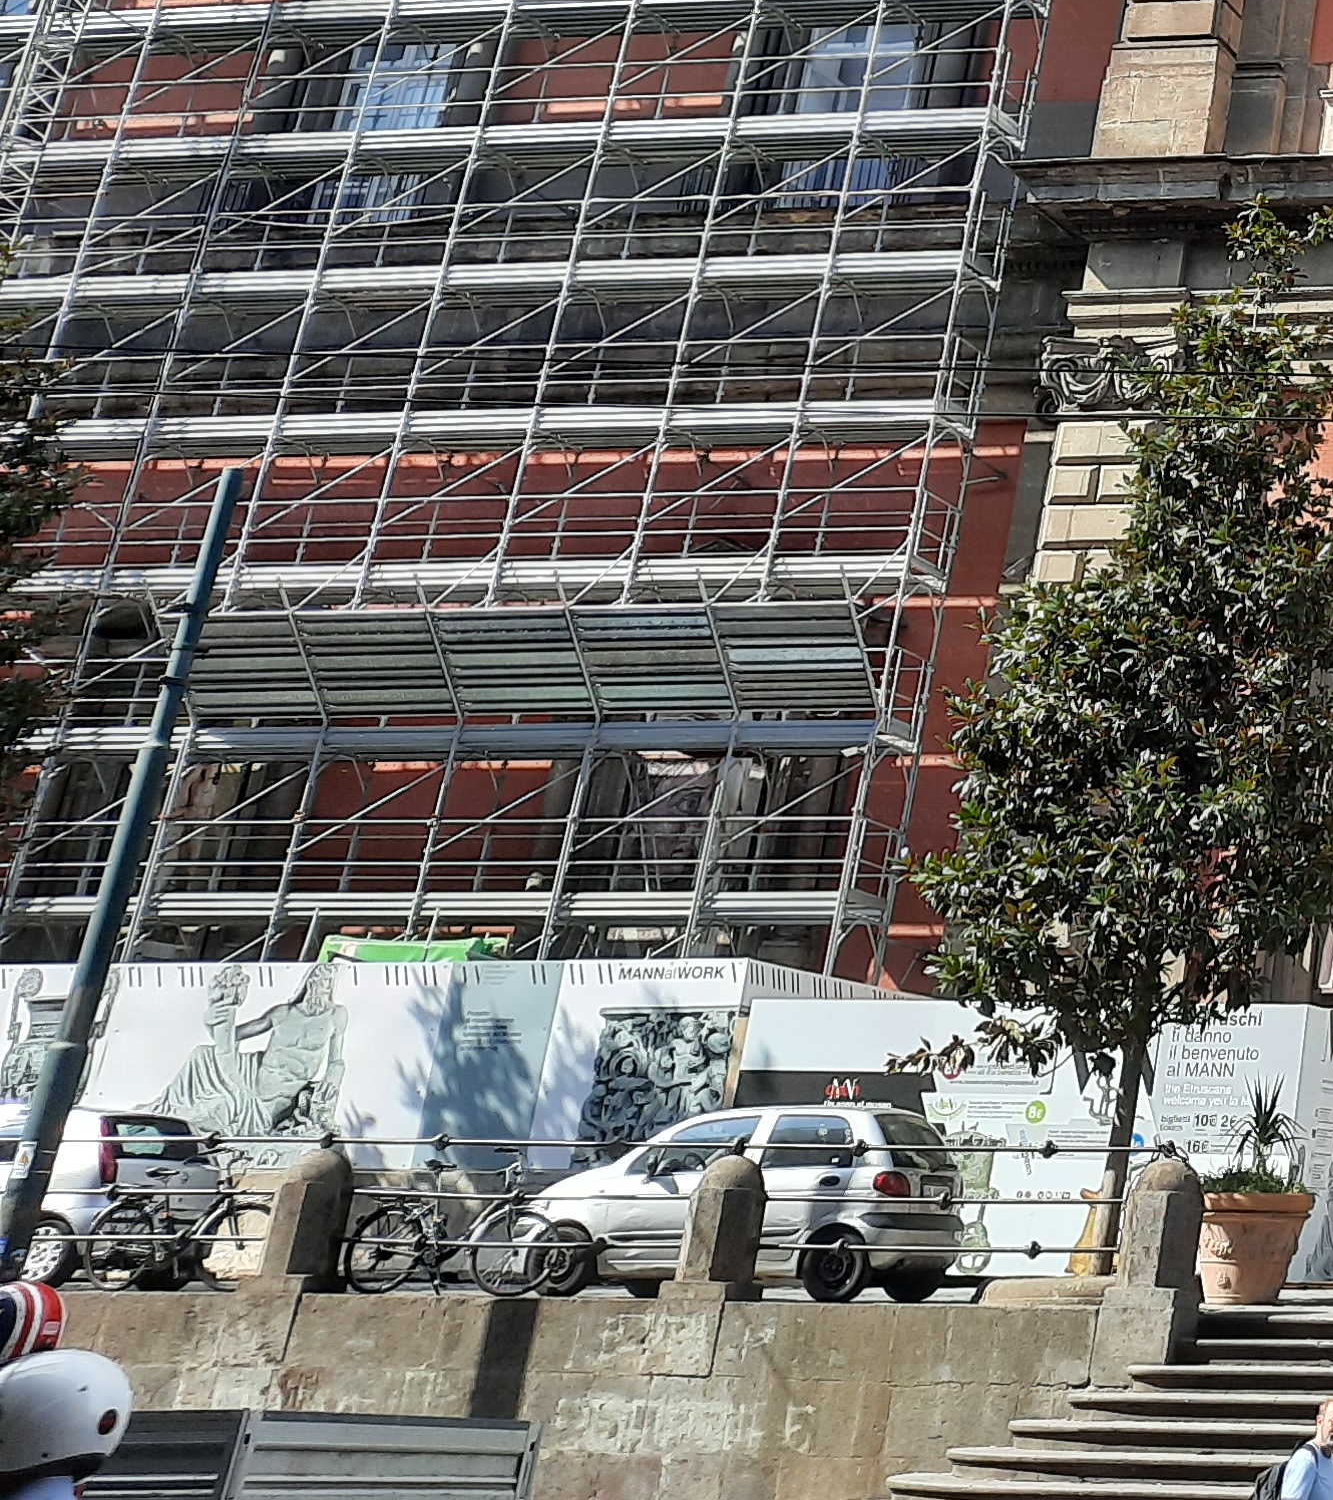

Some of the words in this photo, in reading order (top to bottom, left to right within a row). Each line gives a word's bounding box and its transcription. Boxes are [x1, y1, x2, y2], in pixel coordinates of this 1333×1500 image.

[1185, 1026, 1232, 1043] danno
[1181, 1045, 1260, 1061] benvenuto
[1166, 1062, 1181, 1077] al
[1185, 1062, 1235, 1077] MANN
